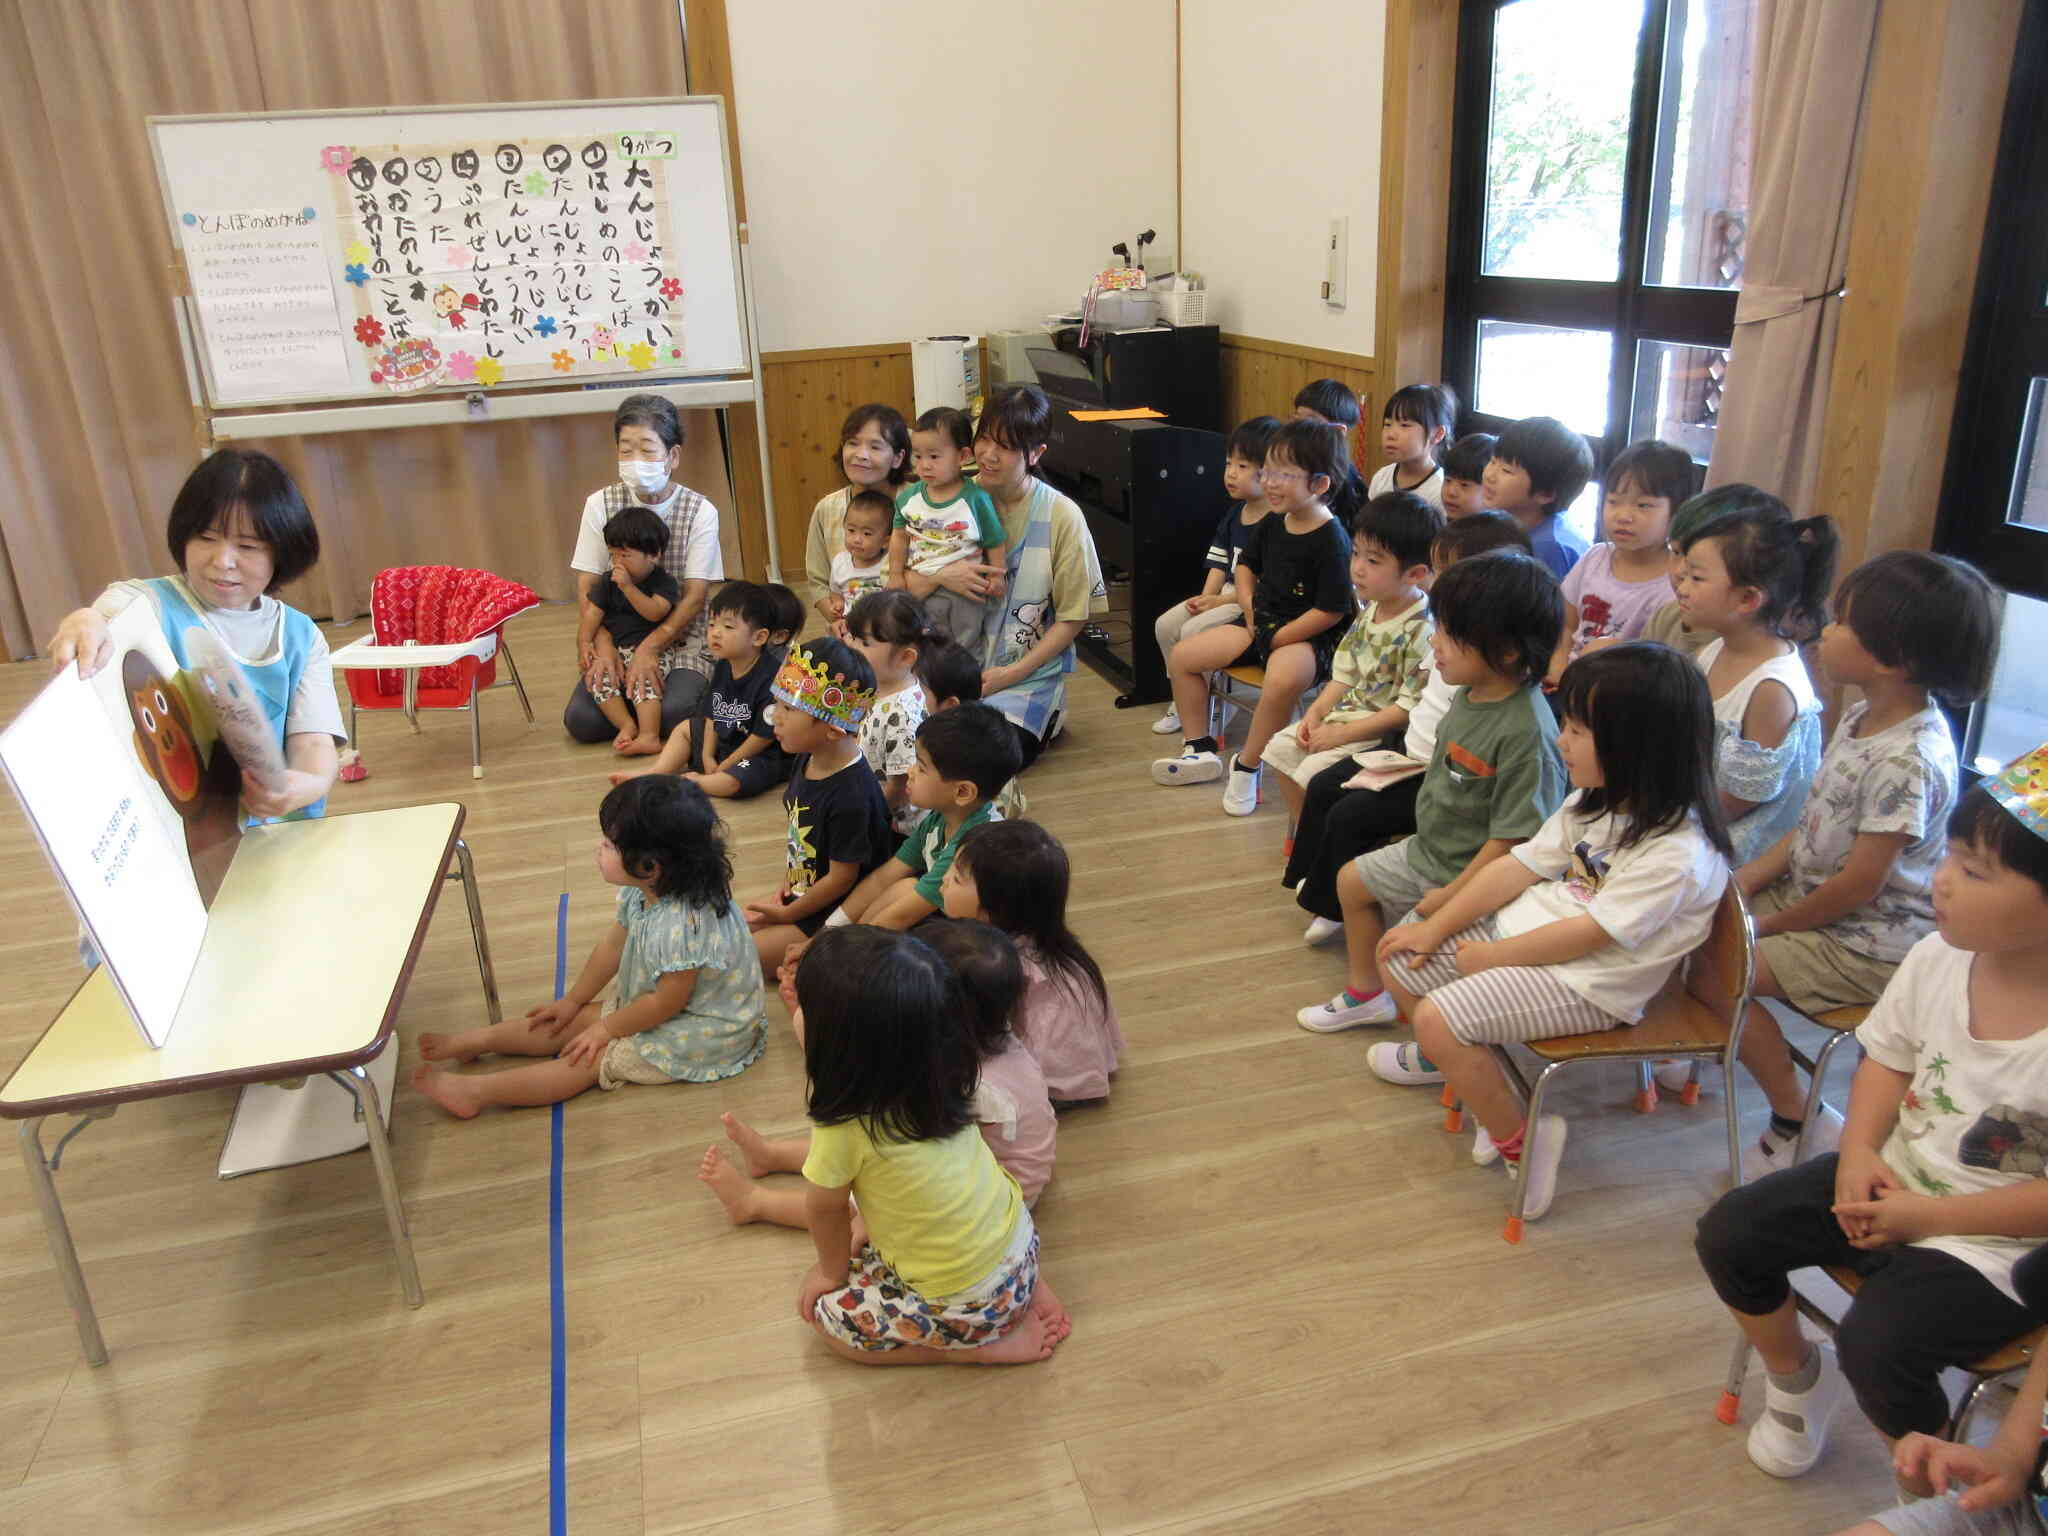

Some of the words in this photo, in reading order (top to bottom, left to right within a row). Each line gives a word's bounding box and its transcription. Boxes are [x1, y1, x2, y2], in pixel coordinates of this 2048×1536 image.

[623, 160, 674, 347] たんじょうかい
